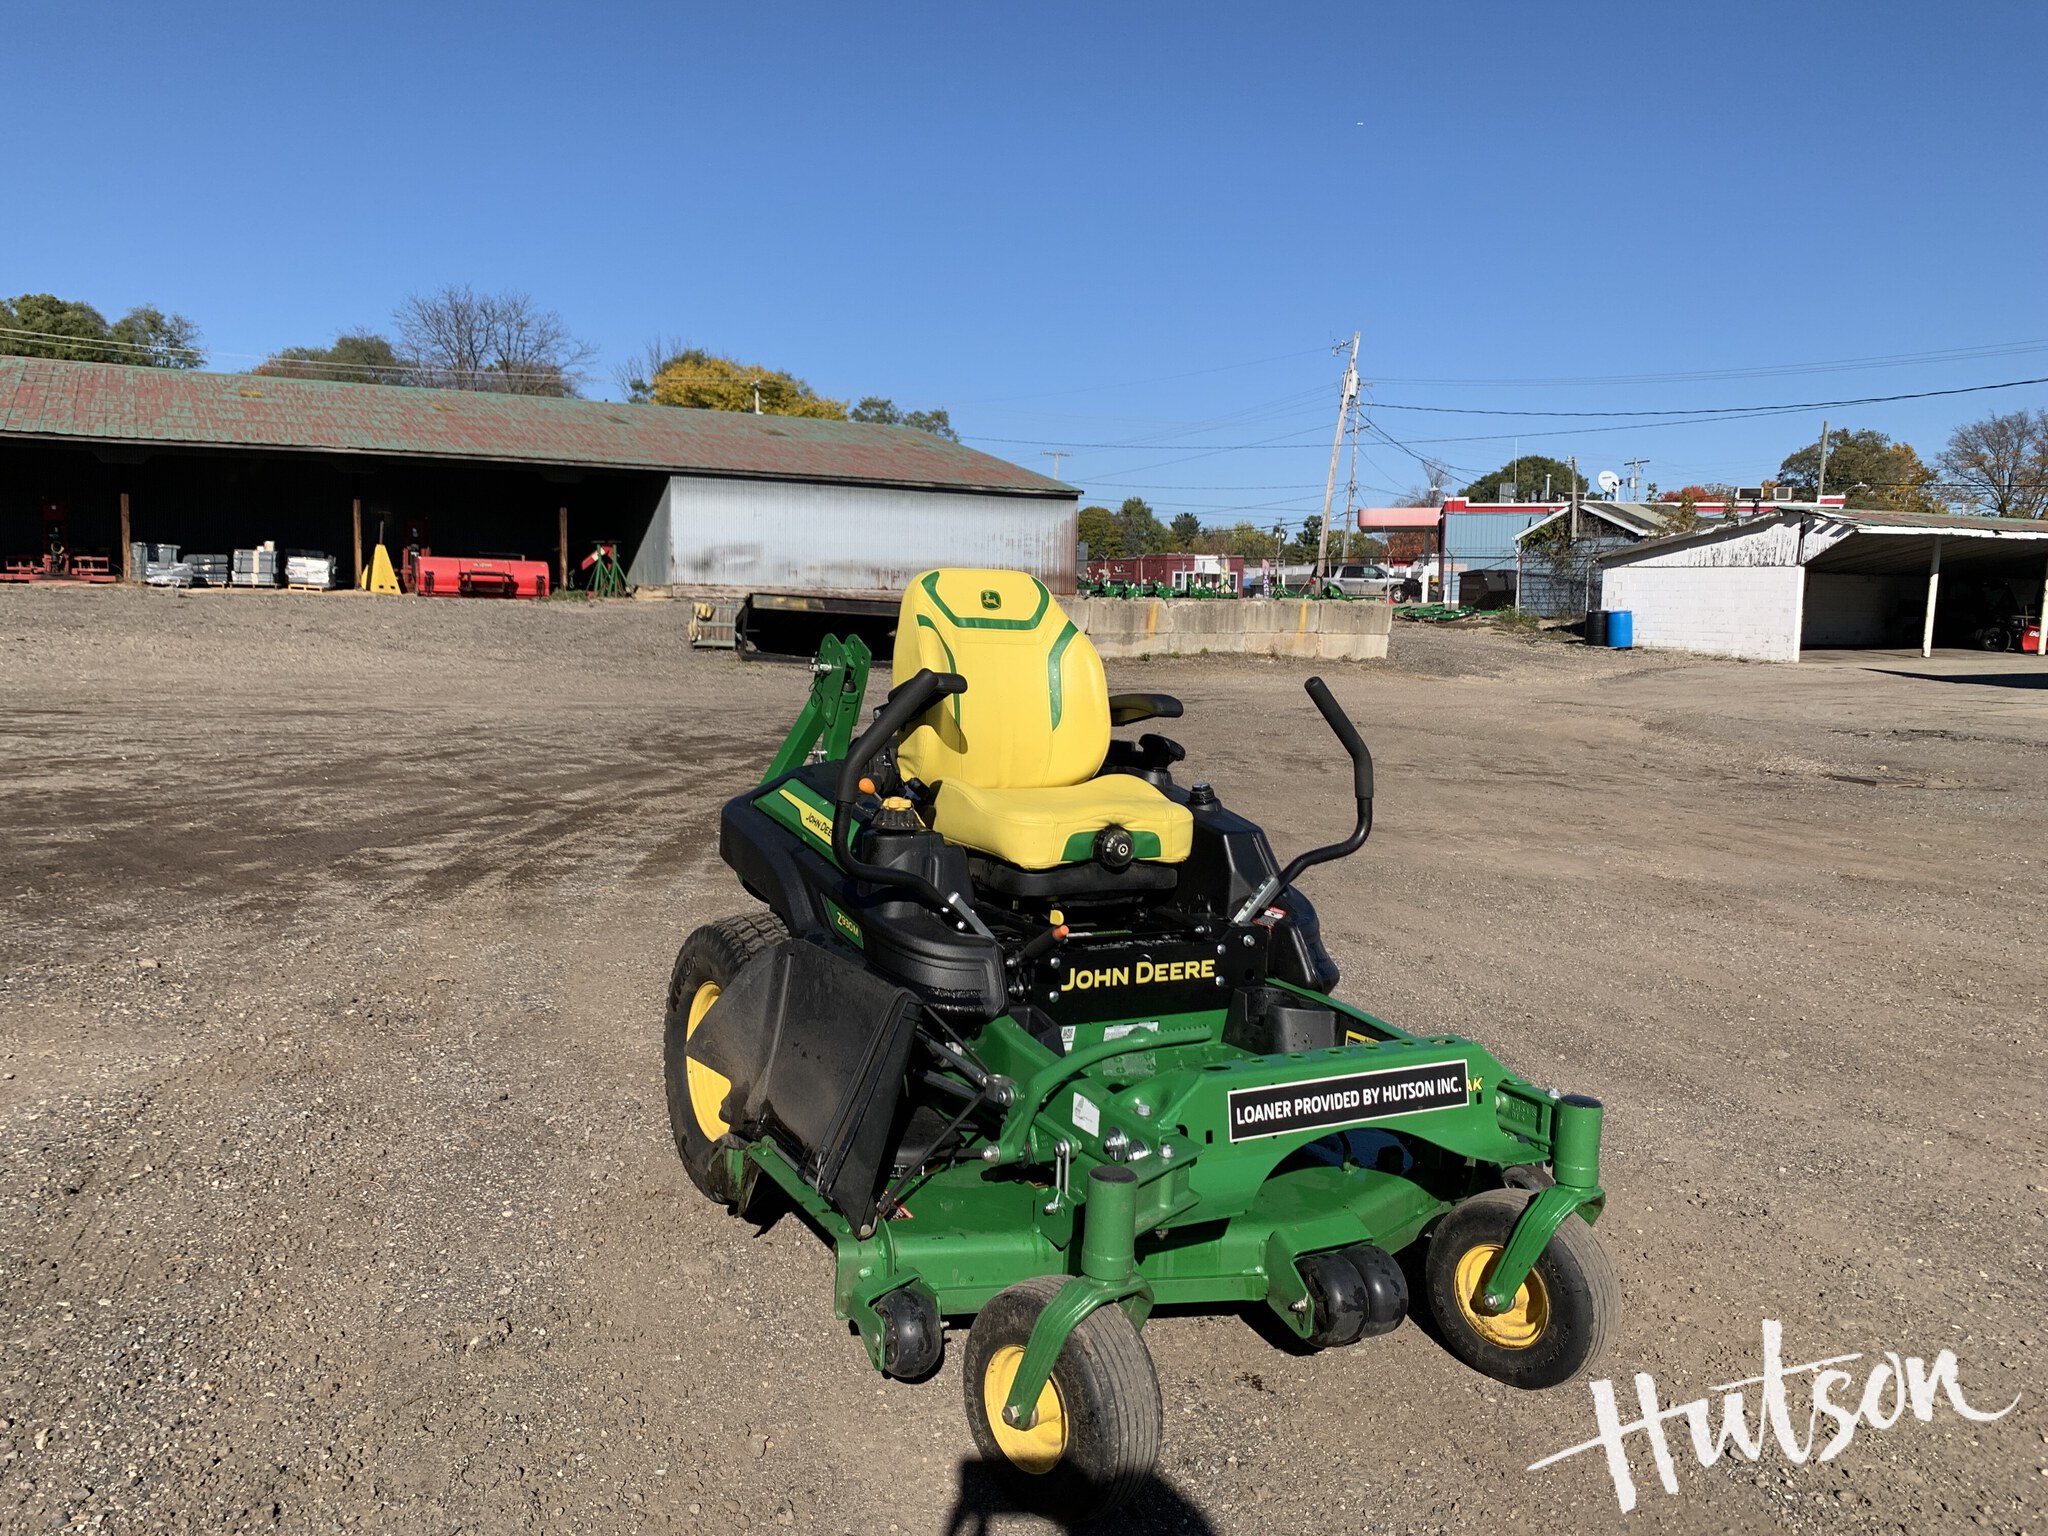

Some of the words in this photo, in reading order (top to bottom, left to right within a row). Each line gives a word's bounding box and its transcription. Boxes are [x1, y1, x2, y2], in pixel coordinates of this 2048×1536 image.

[805, 812, 822, 829] JOHN
[1060, 967, 1129, 992] JOHN
[1135, 959, 1215, 984] DEERE
[1236, 1100, 1291, 1125] LOANER
[1294, 1090, 1360, 1116] PROVIDED
[1364, 1085, 1380, 1104] BY
[1382, 1079, 1434, 1103] HUTSON
[1437, 1076, 1462, 1094] INC.
